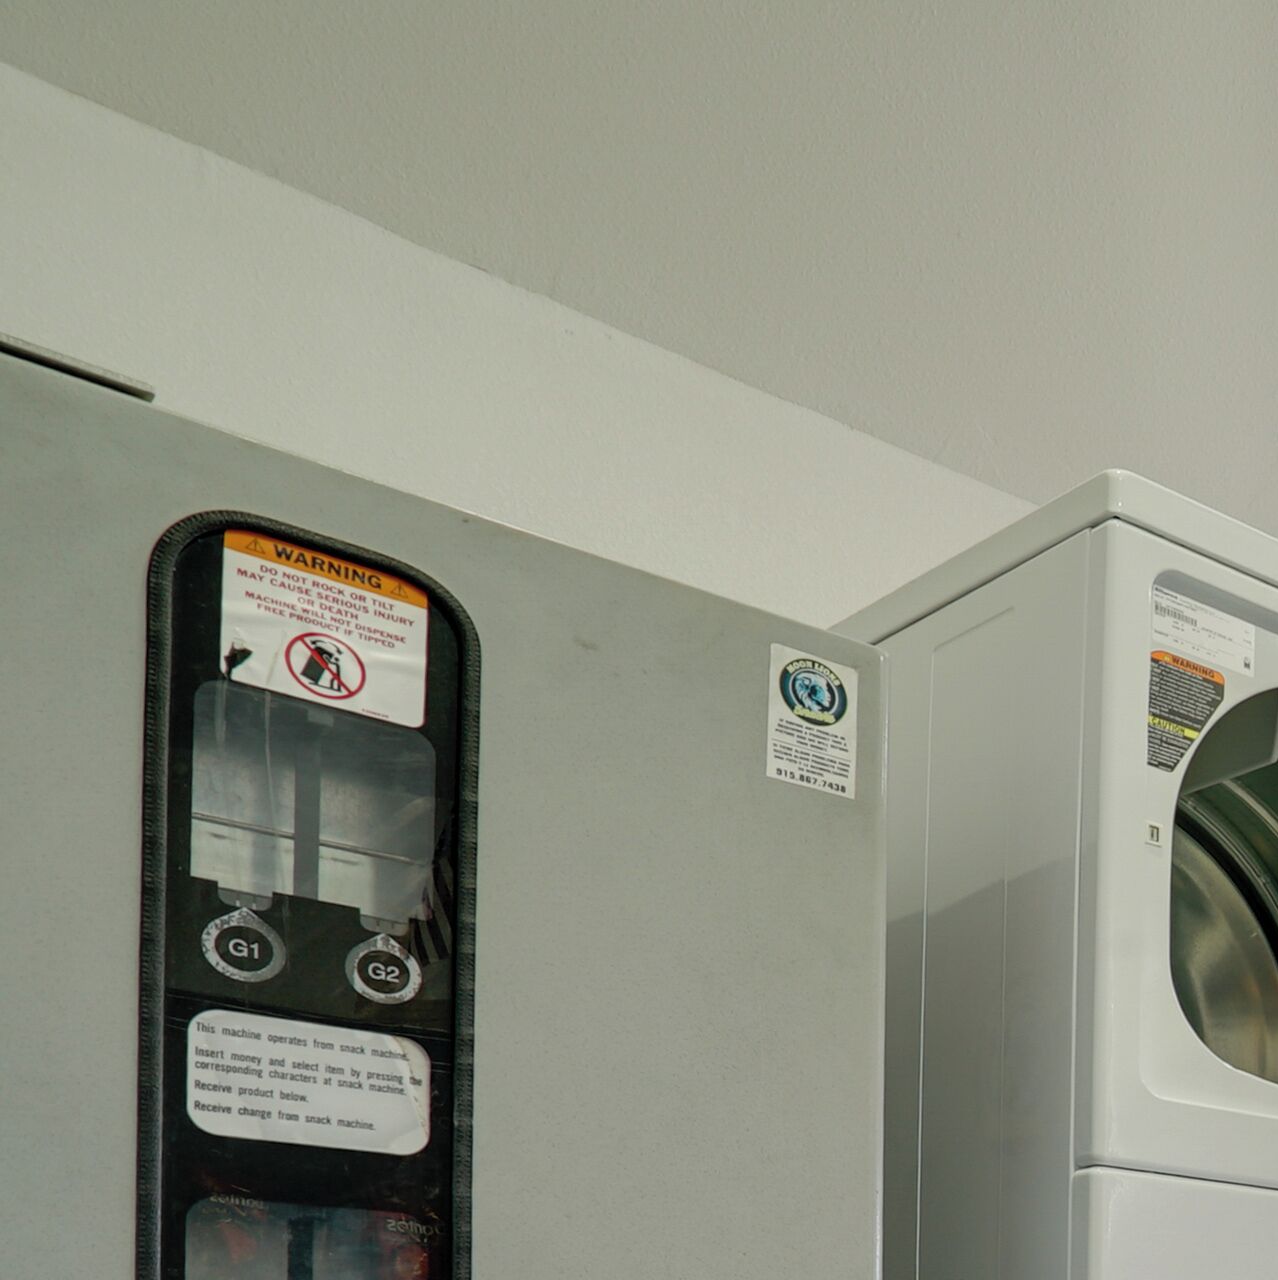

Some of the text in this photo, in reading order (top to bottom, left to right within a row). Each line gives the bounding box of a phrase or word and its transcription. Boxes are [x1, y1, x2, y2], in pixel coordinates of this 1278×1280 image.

[274, 543, 381, 589] WARNING
[237, 568, 415, 627] MAY CAUSE SERIOUS INJURY
[260, 565, 394, 611] DO NOT ROCK OR TILT
[245, 590, 406, 644] MACHINE WILL NOT DISPENSE
[298, 597, 358, 620] OR DEATH
[257, 603, 395, 648] FREE PRODUCT IF TIPPED
[1171, 655, 1215, 678] WARNING
[1151, 716, 1185, 735] CAUTION
[229, 939, 259, 959] G1
[368, 963, 400, 983] G2
[196, 1022, 215, 1034] This
[222, 1026, 261, 1041] machine
[268, 1032, 307, 1048] operates
[314, 1039, 334, 1051] from
[340, 1042, 366, 1055] snack
[195, 1046, 423, 1087] Insert money and select item by pressing the
[195, 1060, 263, 1079] corresponding
[269, 1069, 317, 1085] characters
[323, 1075, 332, 1086] at
[338, 1077, 363, 1090] snack
[194, 1080, 232, 1094] Receive
[239, 1085, 274, 1099] product
[194, 1100, 232, 1114] Receive
[238, 1105, 271, 1119] change
[278, 1109, 299, 1122] from
[305, 1113, 331, 1126] snack
